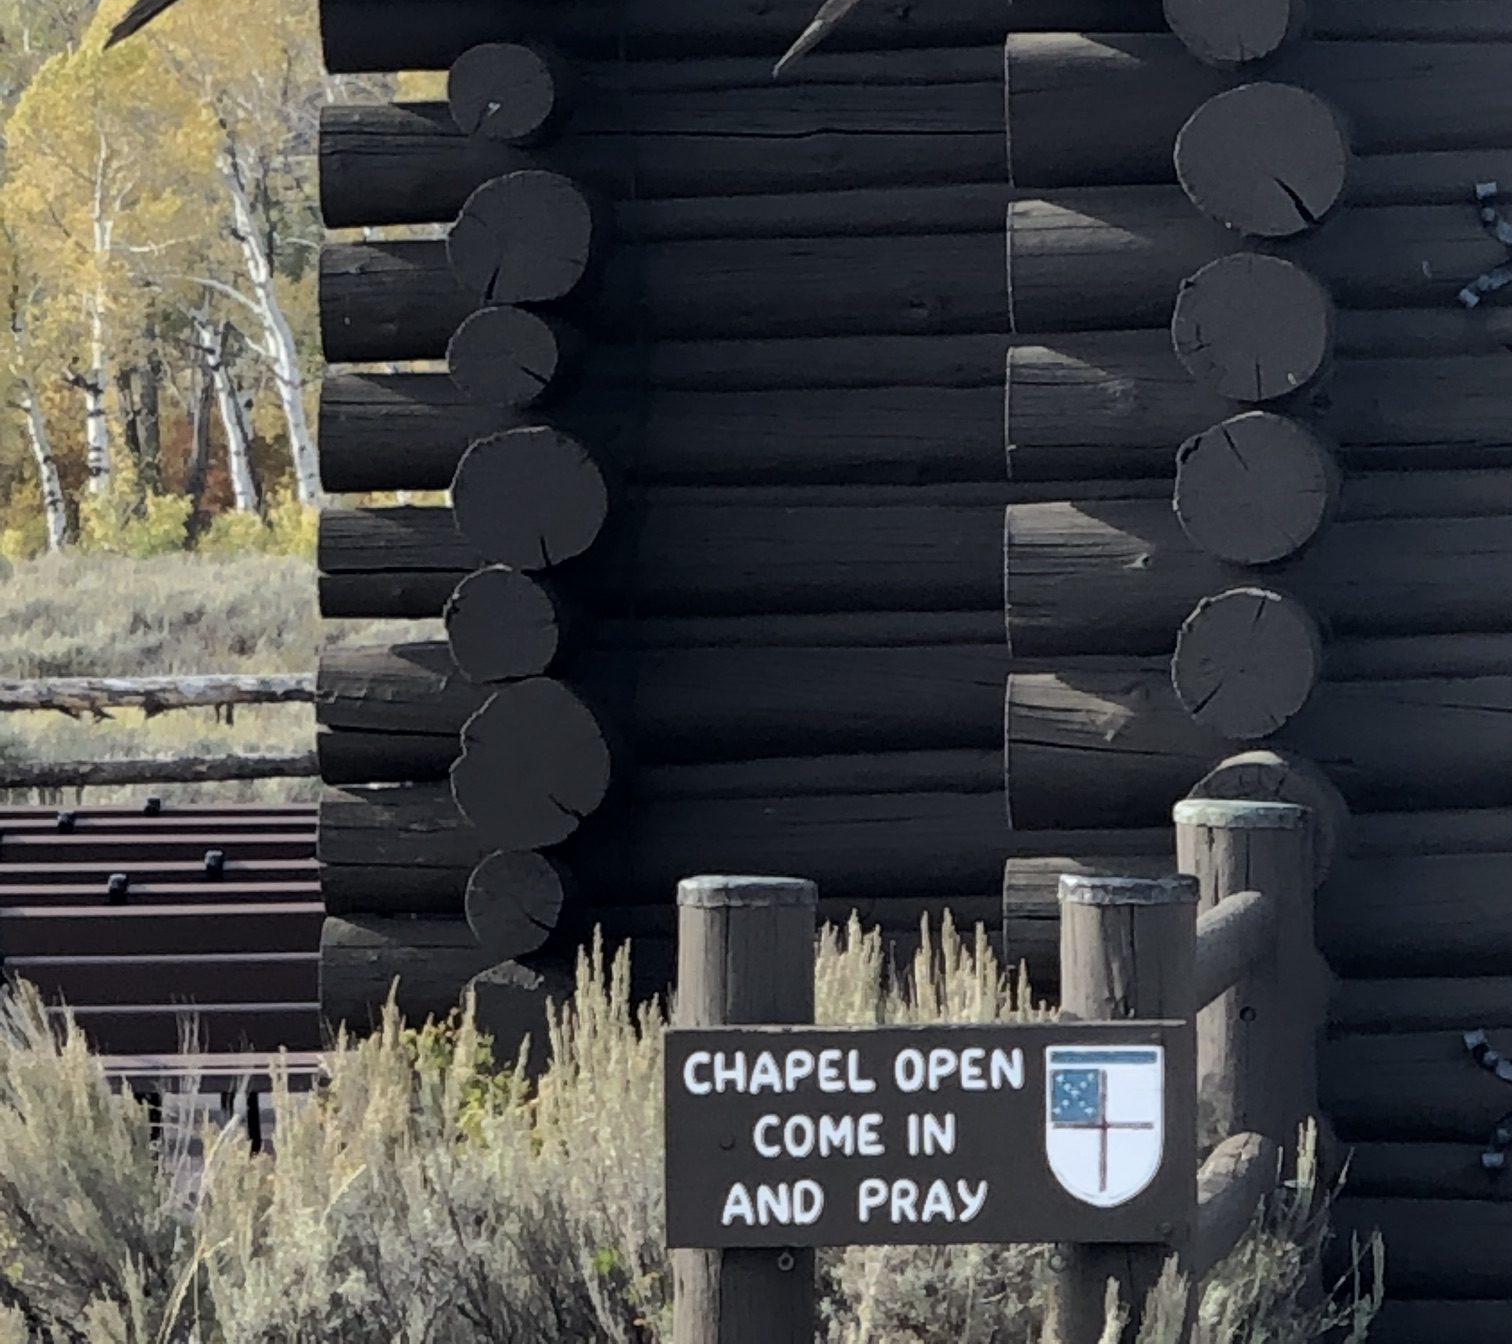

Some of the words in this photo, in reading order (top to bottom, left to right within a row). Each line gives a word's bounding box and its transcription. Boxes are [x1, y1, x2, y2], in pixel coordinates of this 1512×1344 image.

[682, 1048, 877, 1096] CHAPEL
[893, 1046, 1025, 1093] OPEN
[752, 1112, 886, 1159] COME
[906, 1112, 956, 1157] IN
[720, 1178, 825, 1227] AND
[857, 1177, 989, 1224] PRAY
